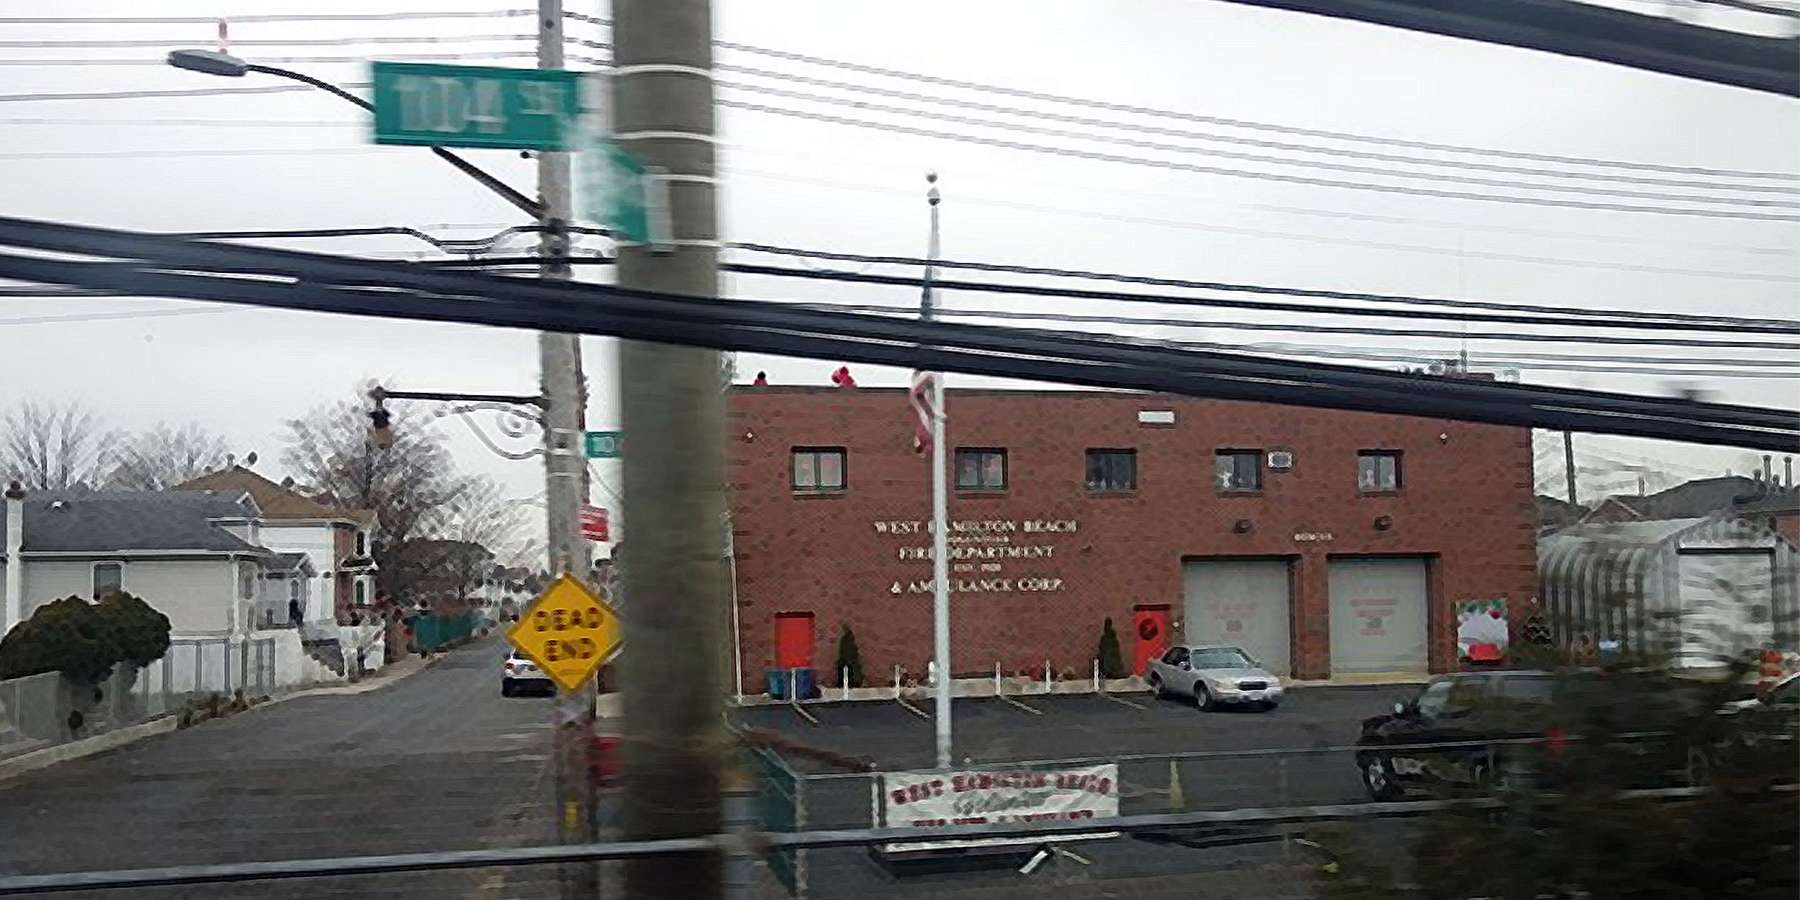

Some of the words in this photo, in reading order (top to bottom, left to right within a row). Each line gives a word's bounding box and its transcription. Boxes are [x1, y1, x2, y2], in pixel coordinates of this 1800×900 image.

[874, 521, 921, 533] WEST
[1024, 520, 1077, 533] BEACH
[899, 546, 936, 559] FIRE
[944, 545, 1054, 559] DEPARTMENT
[890, 581, 902, 593] &
[908, 578, 1011, 592] AMULANCE
[533, 607, 604, 632] DEAD
[544, 637, 597, 661] END
